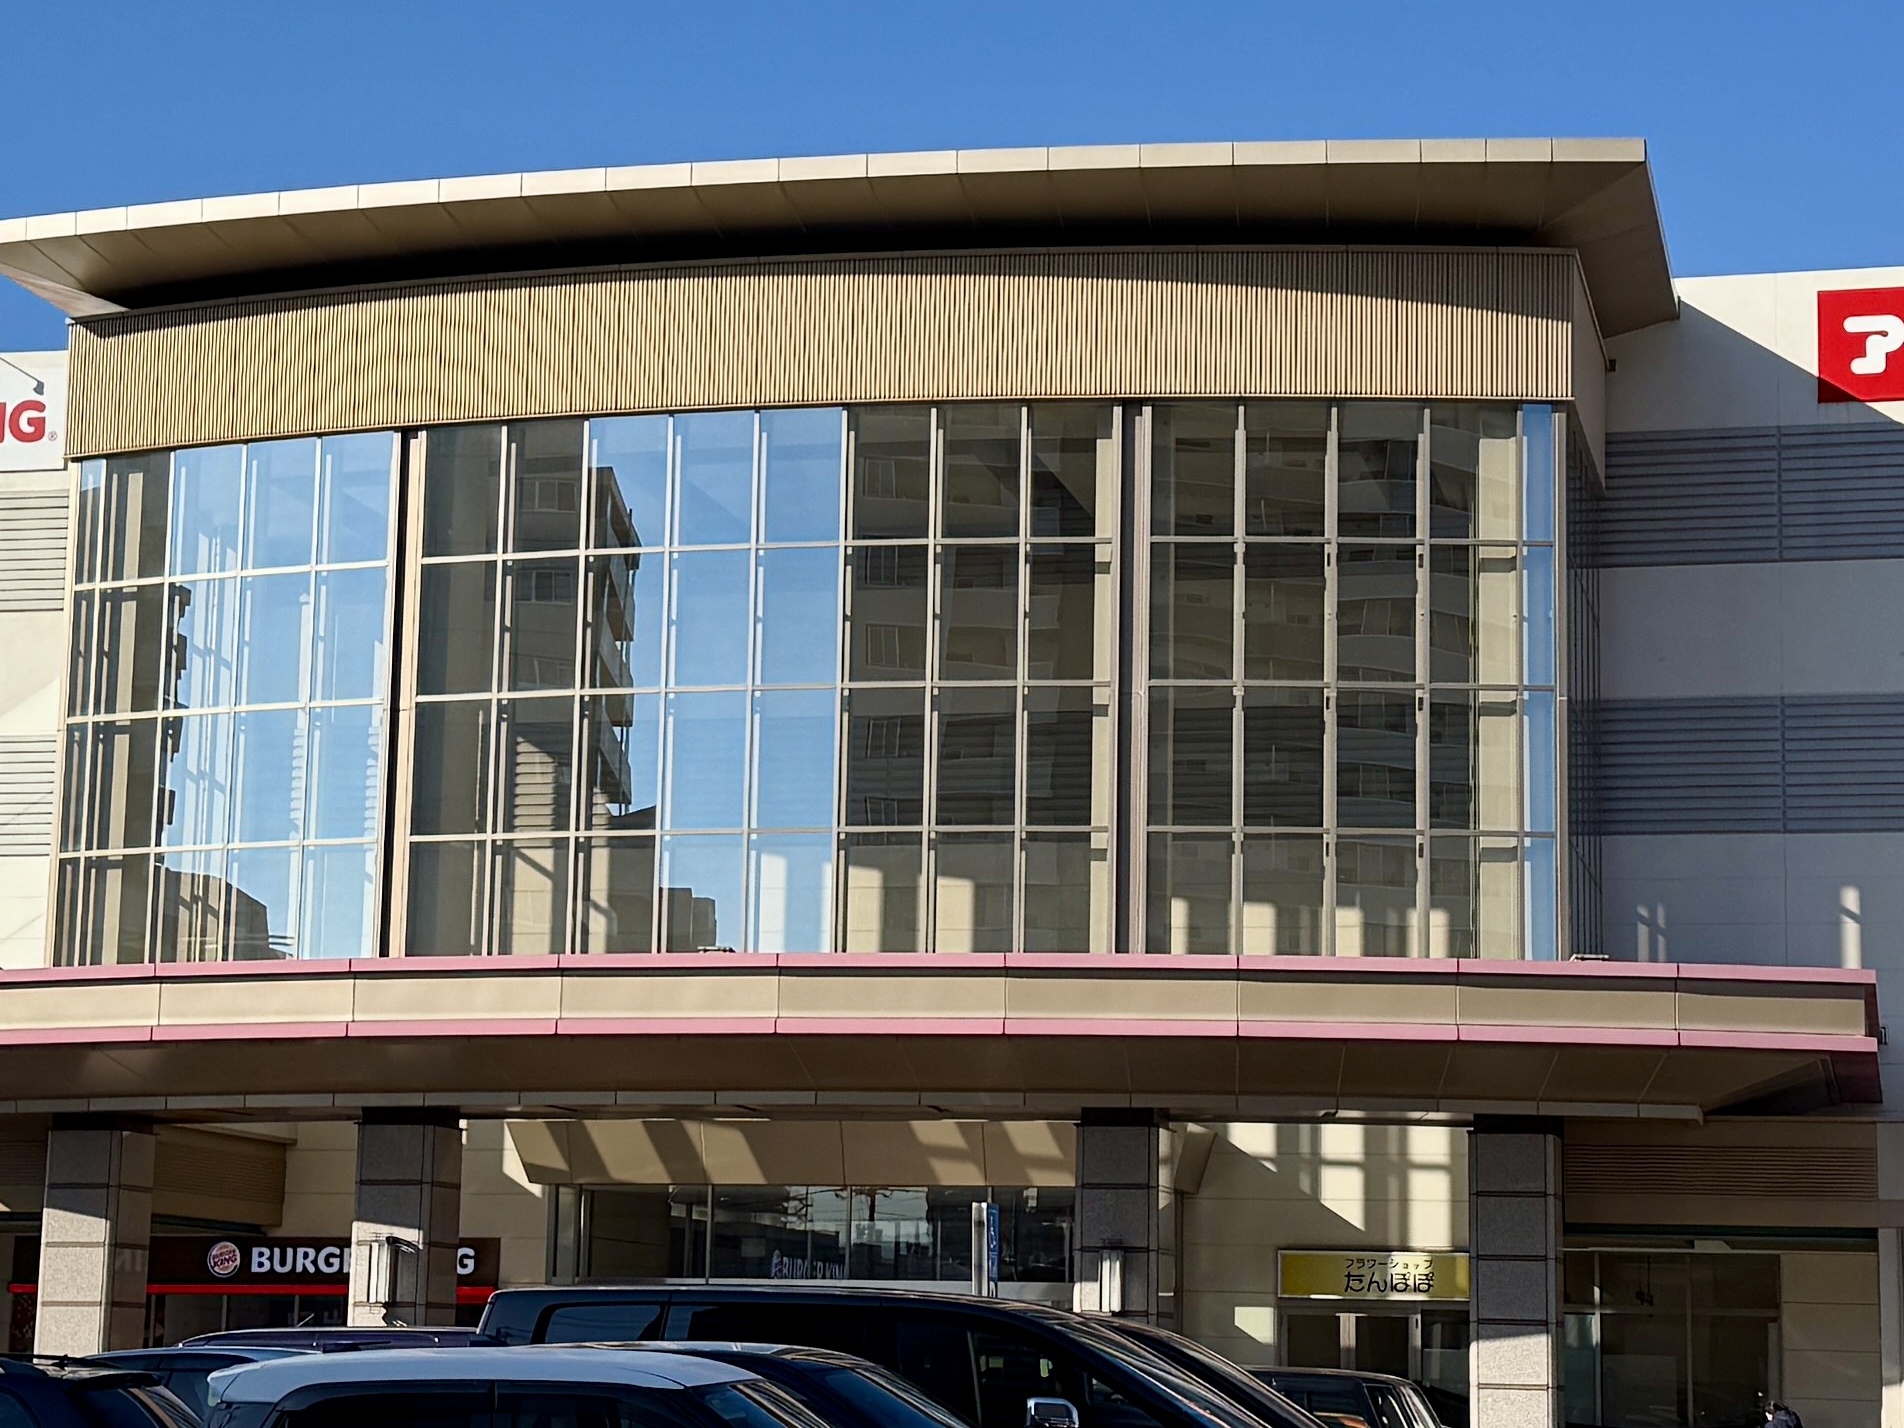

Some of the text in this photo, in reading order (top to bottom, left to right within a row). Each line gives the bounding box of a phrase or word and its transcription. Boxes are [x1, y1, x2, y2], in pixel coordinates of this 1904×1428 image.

[250, 1246, 351, 1274] BURG
[1345, 1257, 1434, 1270] フラワーショップ
[1344, 1271, 1435, 1294] たんぽぽ
